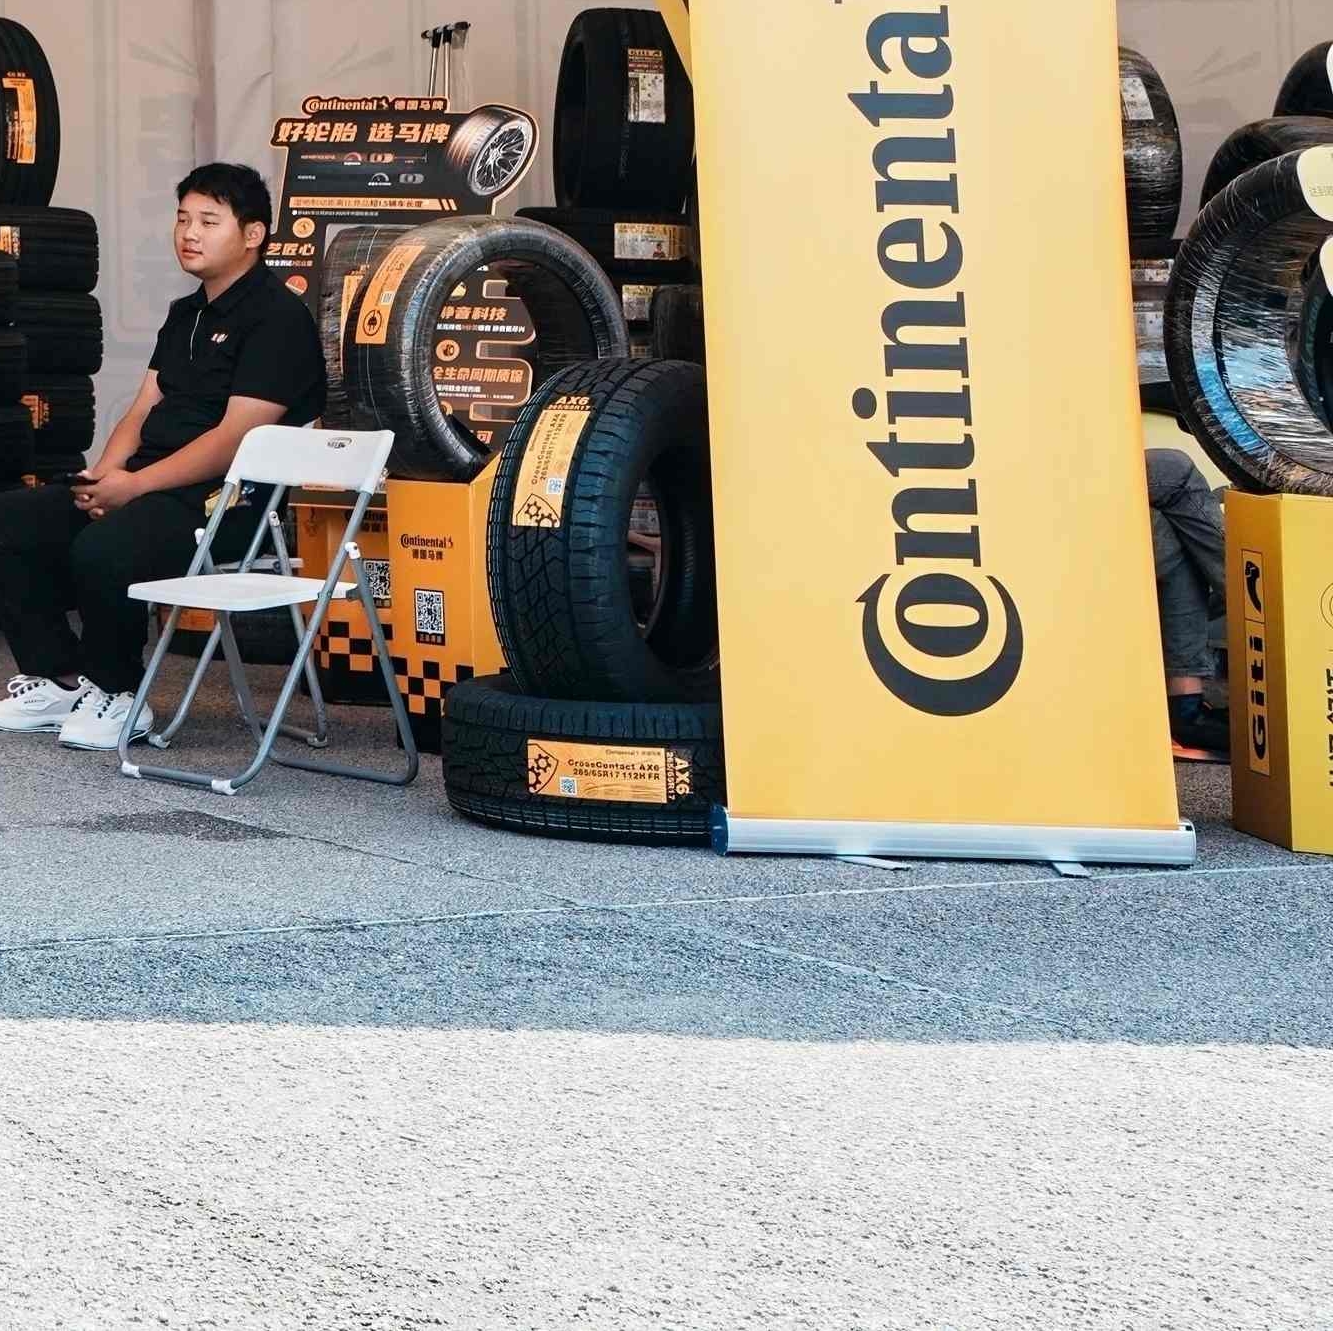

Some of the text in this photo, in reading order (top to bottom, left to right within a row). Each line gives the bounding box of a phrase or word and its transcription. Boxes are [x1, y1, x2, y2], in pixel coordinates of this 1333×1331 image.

[305, 98, 377, 112] Continental
[276, 121, 451, 144] 好轮胎 选马牌
[555, 396, 590, 405] AX6
[400, 533, 447, 549] Continental
[1249, 635, 1266, 760] Giti
[568, 758, 635, 770] CrossContact
[622, 771, 646, 780] 112H
[647, 772, 661, 781] FR
[674, 756, 692, 795] AX6
